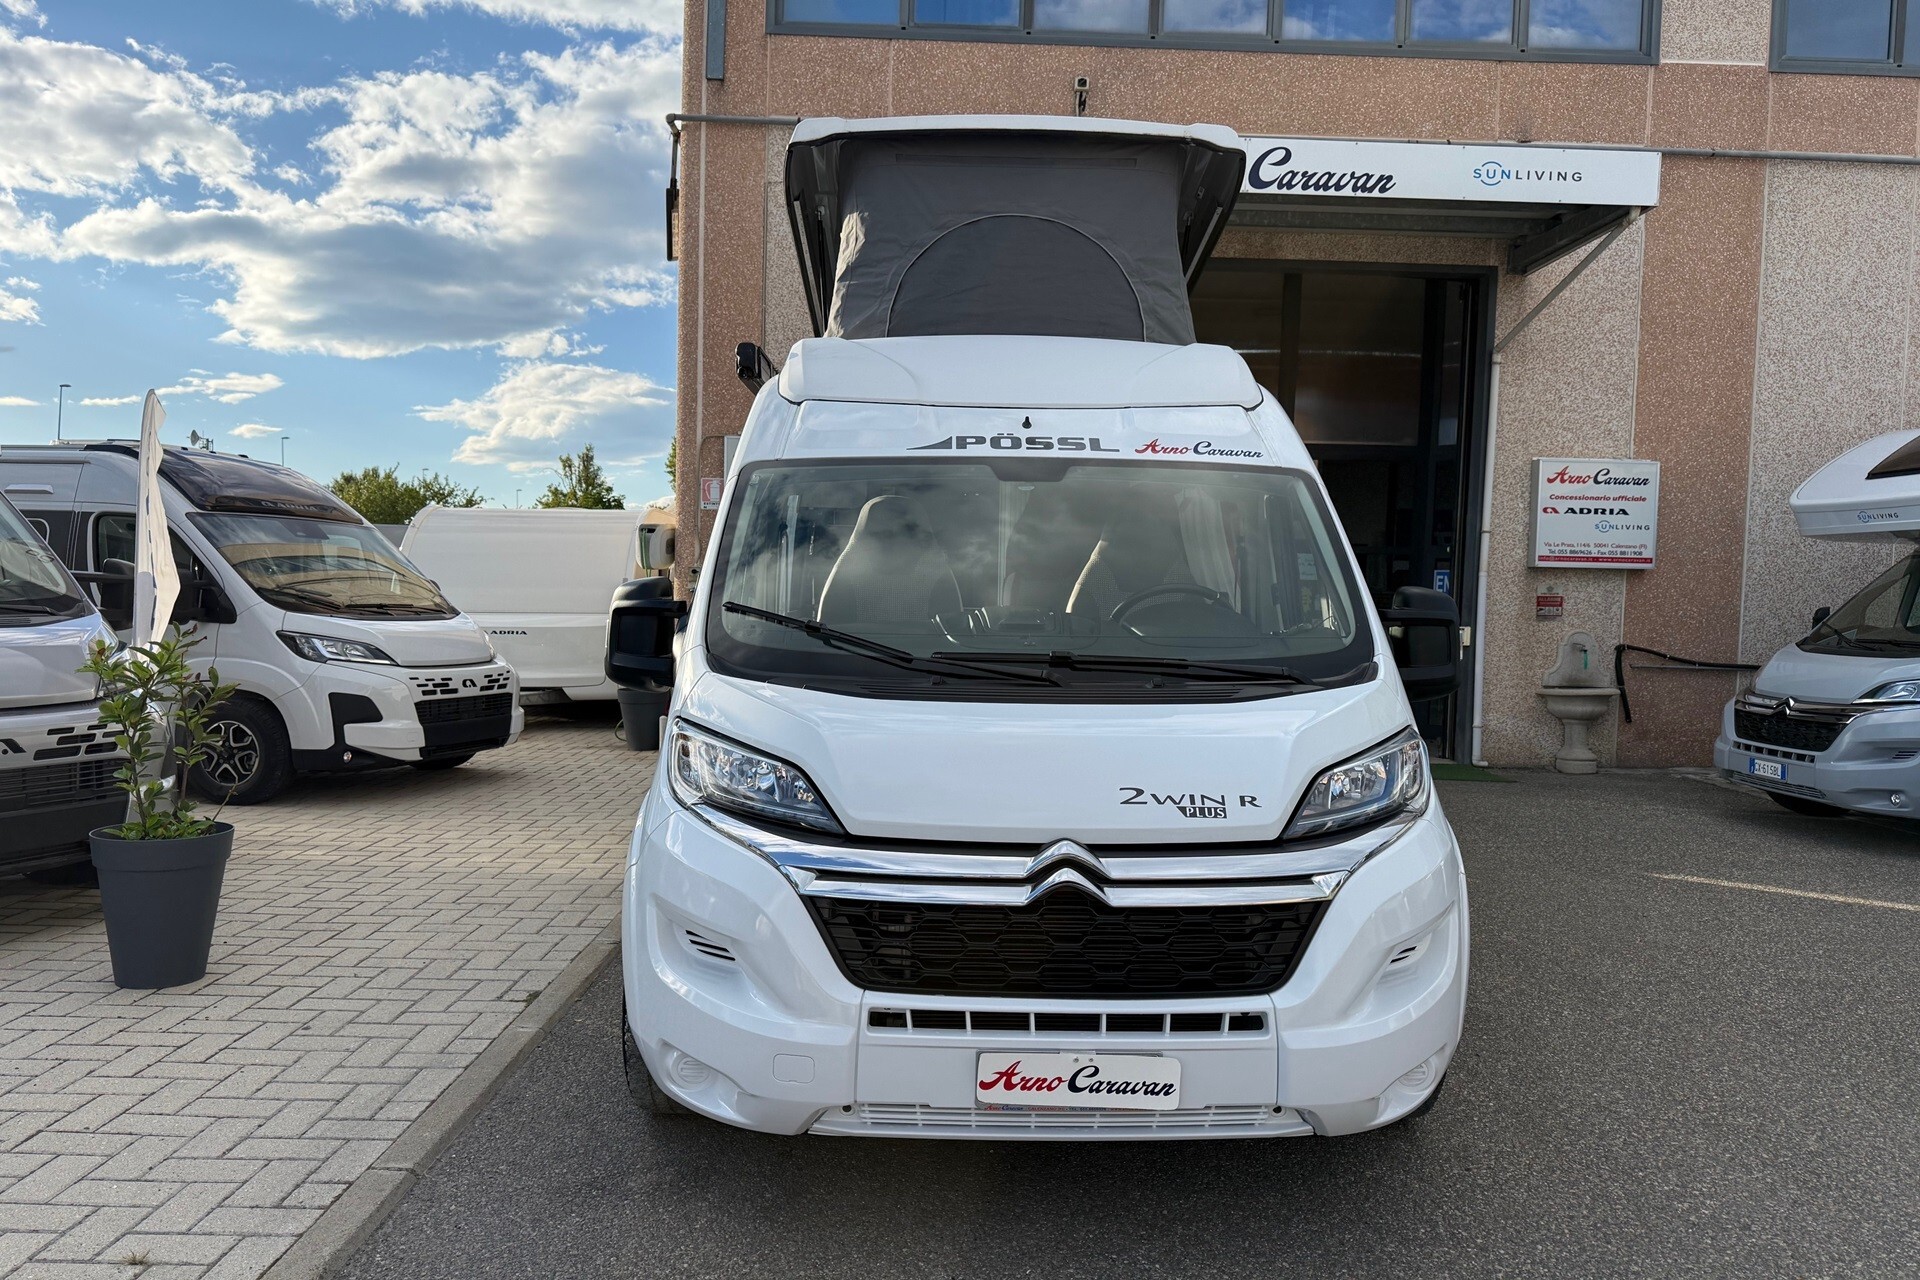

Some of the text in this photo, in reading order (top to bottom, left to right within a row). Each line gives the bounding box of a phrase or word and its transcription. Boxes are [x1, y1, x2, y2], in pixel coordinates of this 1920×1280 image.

[1247, 146, 1396, 194] Caravan
[1472, 164, 1583, 184] SUNLIVING
[955, 433, 1120, 453] PÖSSL
[1134, 438, 1263, 459] Arno Caravan
[1546, 465, 1650, 486] Arno Caravan
[1549, 494, 1612, 502] Concessionario
[1564, 507, 1630, 516] ADRIA
[1857, 512, 1899, 521] SUNLIVING
[1594, 521, 1650, 532] SUNLIVING
[1119, 787, 1262, 808] 2WIN R
[1185, 807, 1225, 818] PLUS
[978, 1060, 1177, 1097] Arno Caravan
